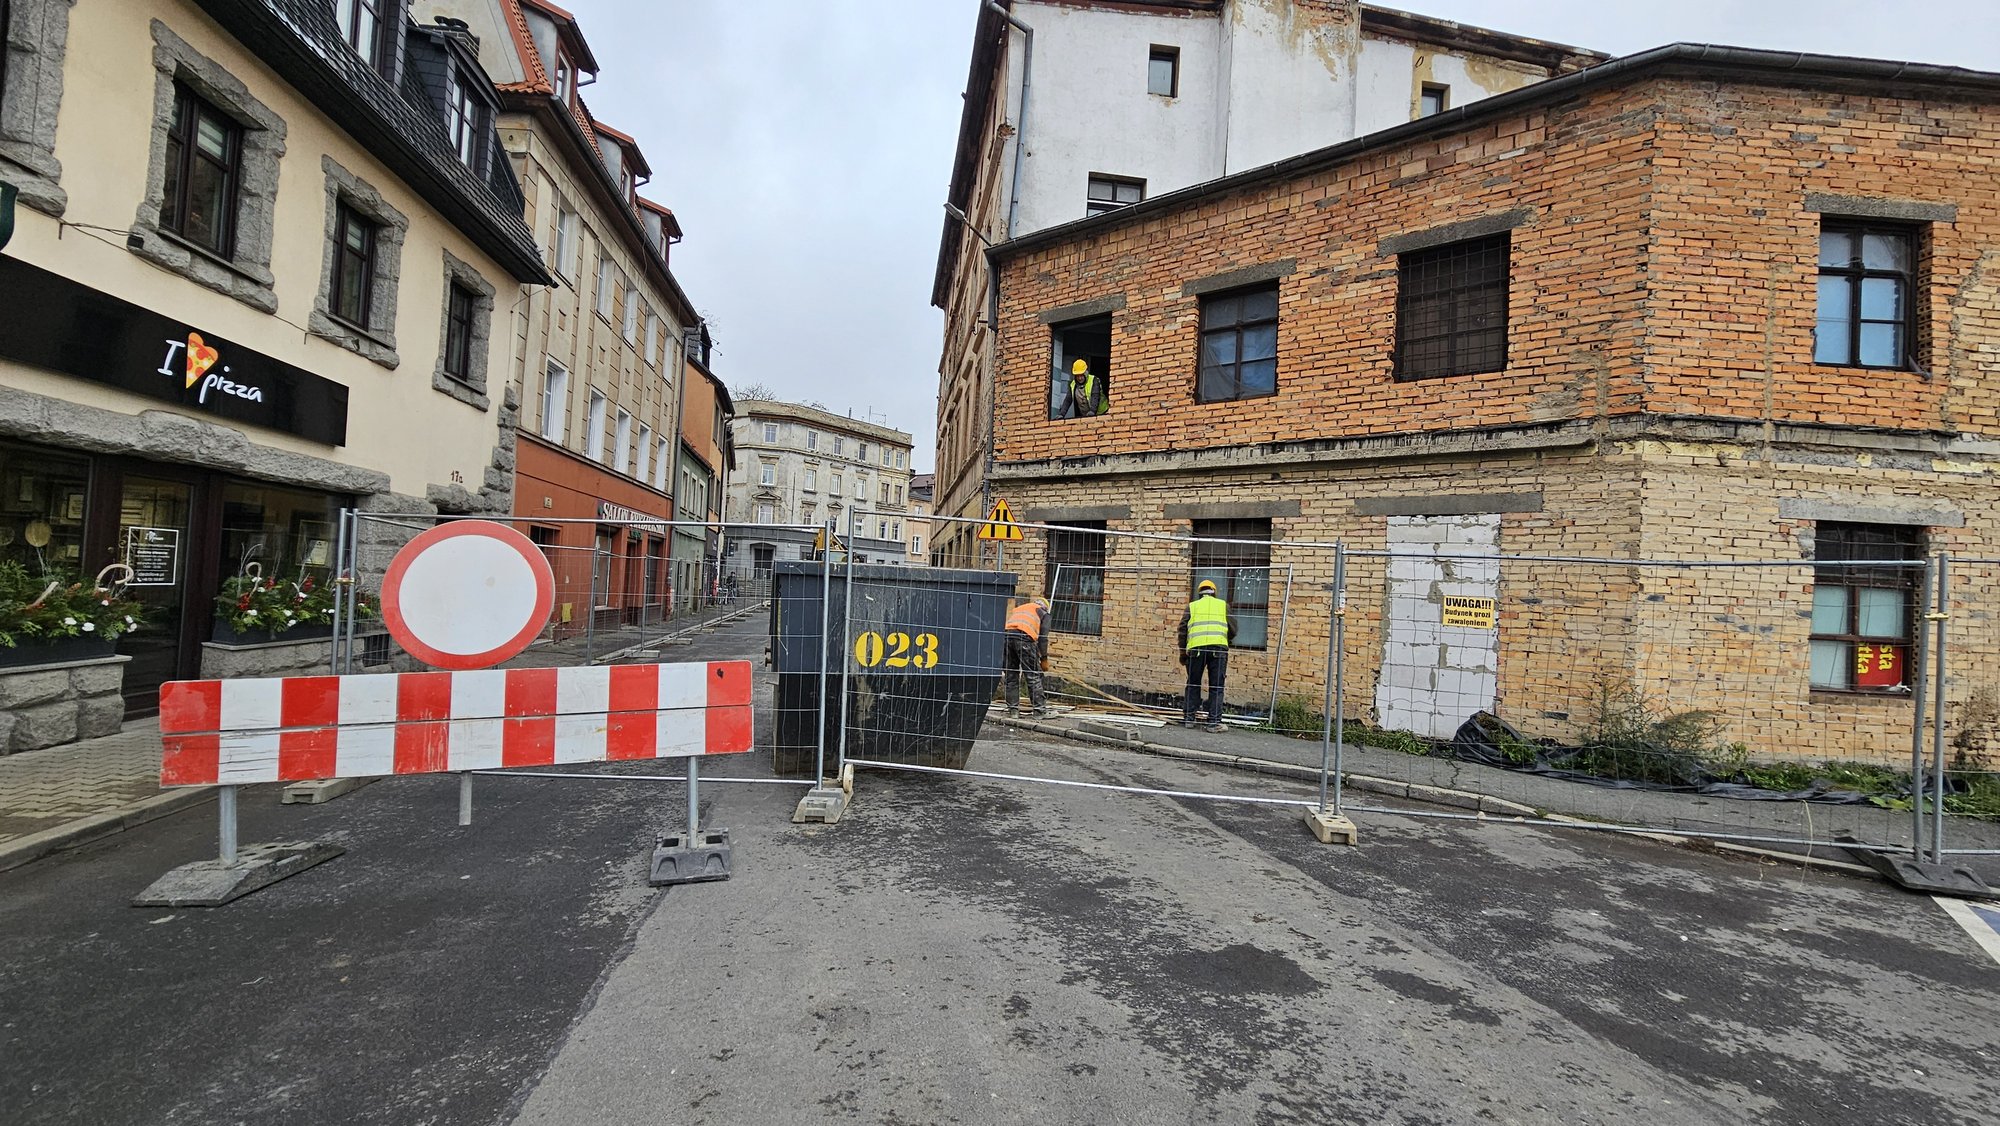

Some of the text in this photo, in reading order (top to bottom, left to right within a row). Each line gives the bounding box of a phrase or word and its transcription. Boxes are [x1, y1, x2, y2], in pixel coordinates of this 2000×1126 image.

[157, 339, 262, 403] I pizza
[1445, 608, 1491, 618] Budynek grozi
[1446, 597, 1492, 609] UWAGA!!!
[855, 631, 938, 668] 023
[1858, 642, 1874, 674] tka
